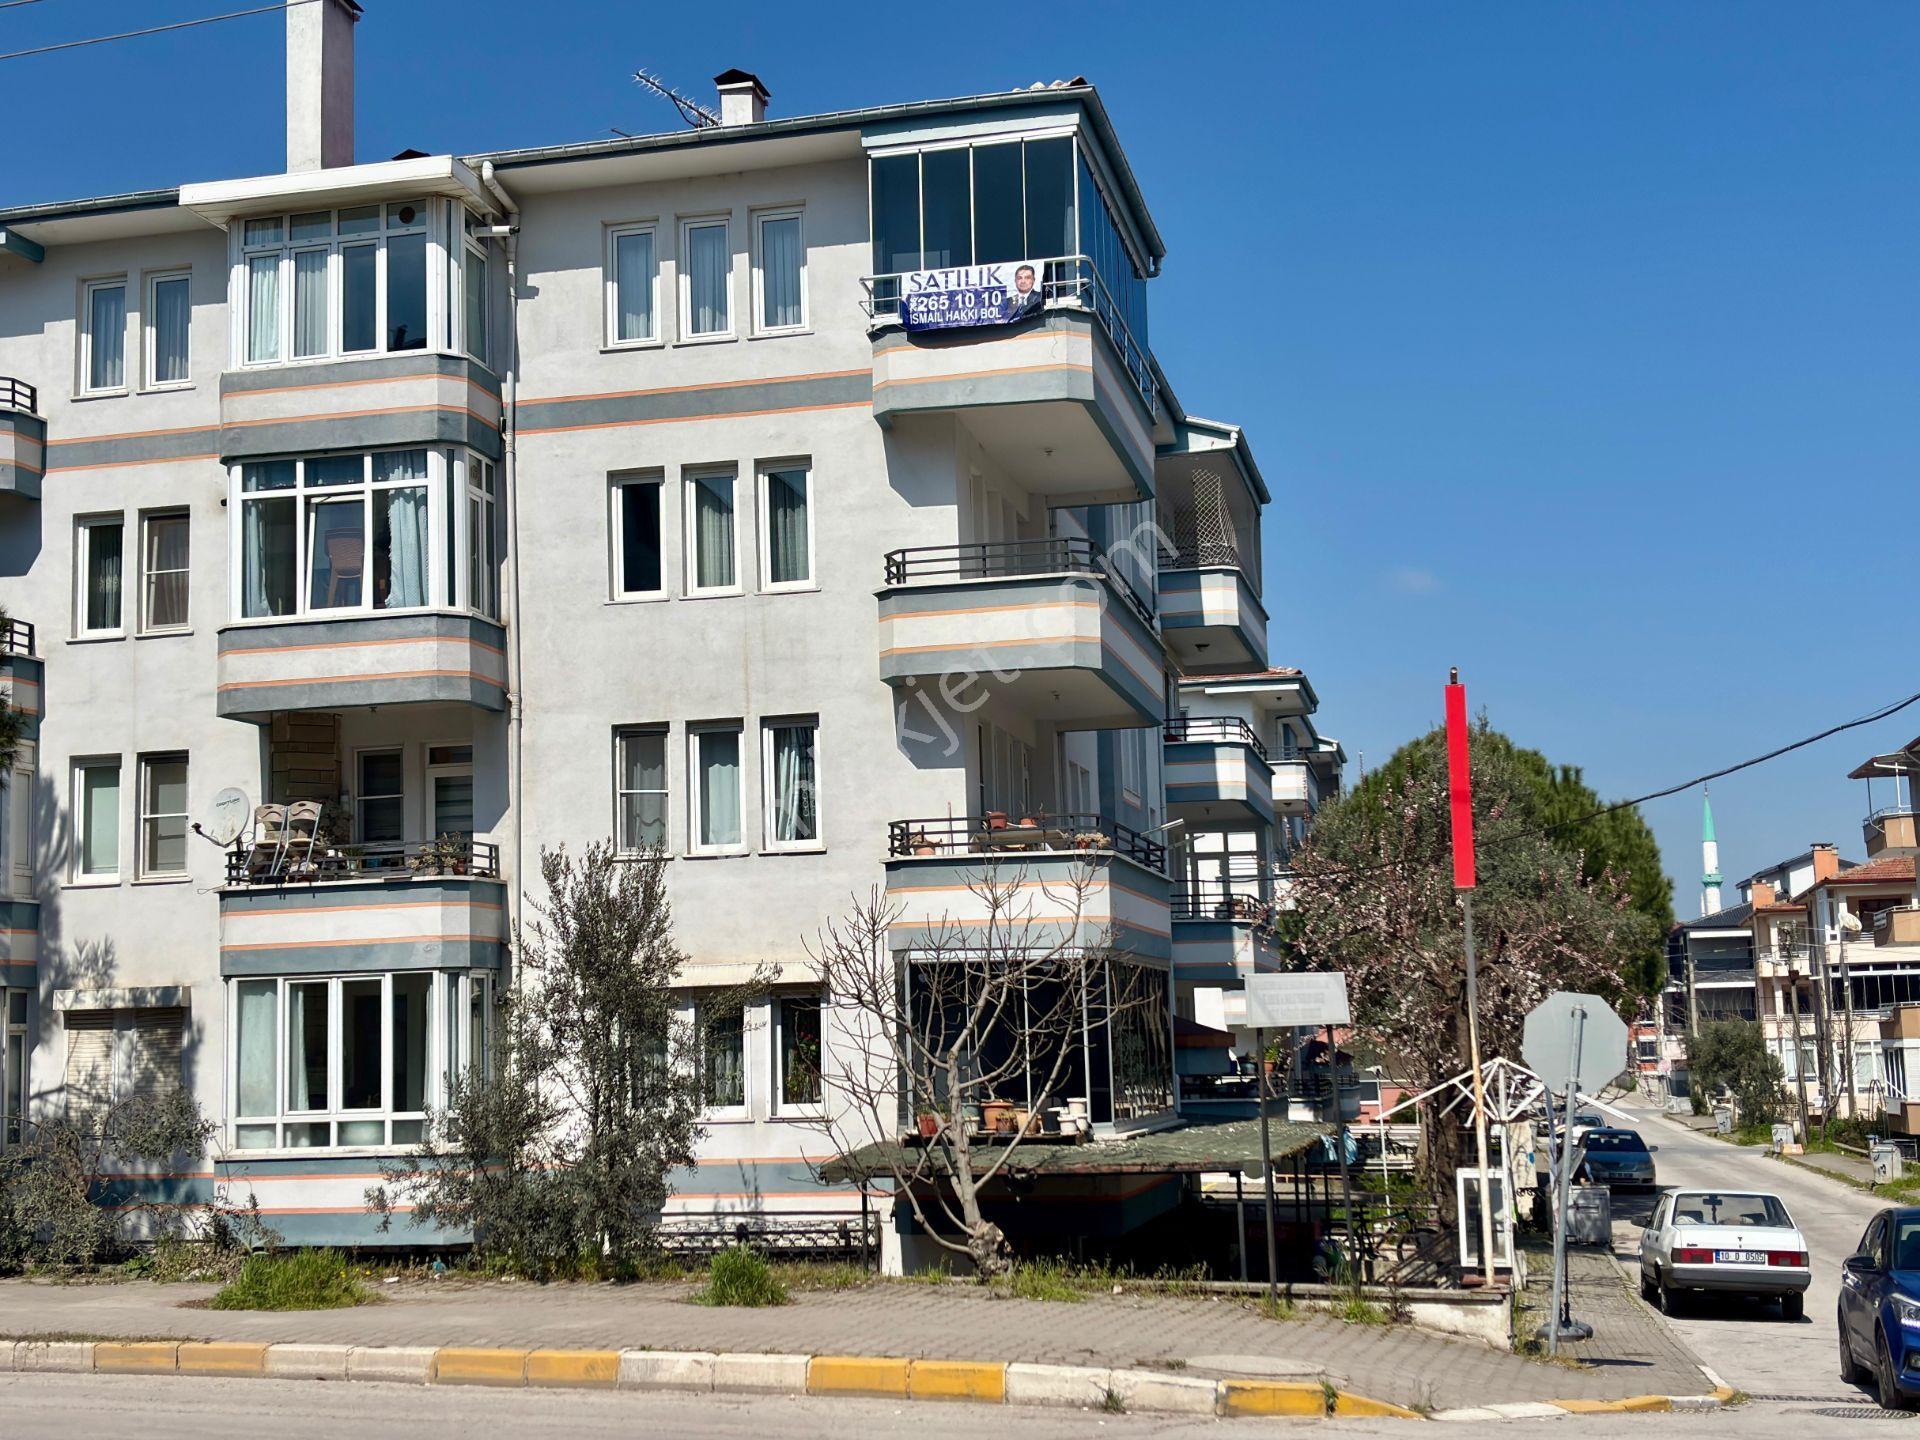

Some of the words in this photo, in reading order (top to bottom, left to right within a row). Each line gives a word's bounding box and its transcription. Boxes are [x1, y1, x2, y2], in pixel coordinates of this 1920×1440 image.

[910, 265, 1003, 292] SATILIK
[917, 295, 949, 312] 265
[955, 292, 975, 309] 10
[981, 290, 1002, 307] 10
[946, 308, 978, 321] HAKKI
